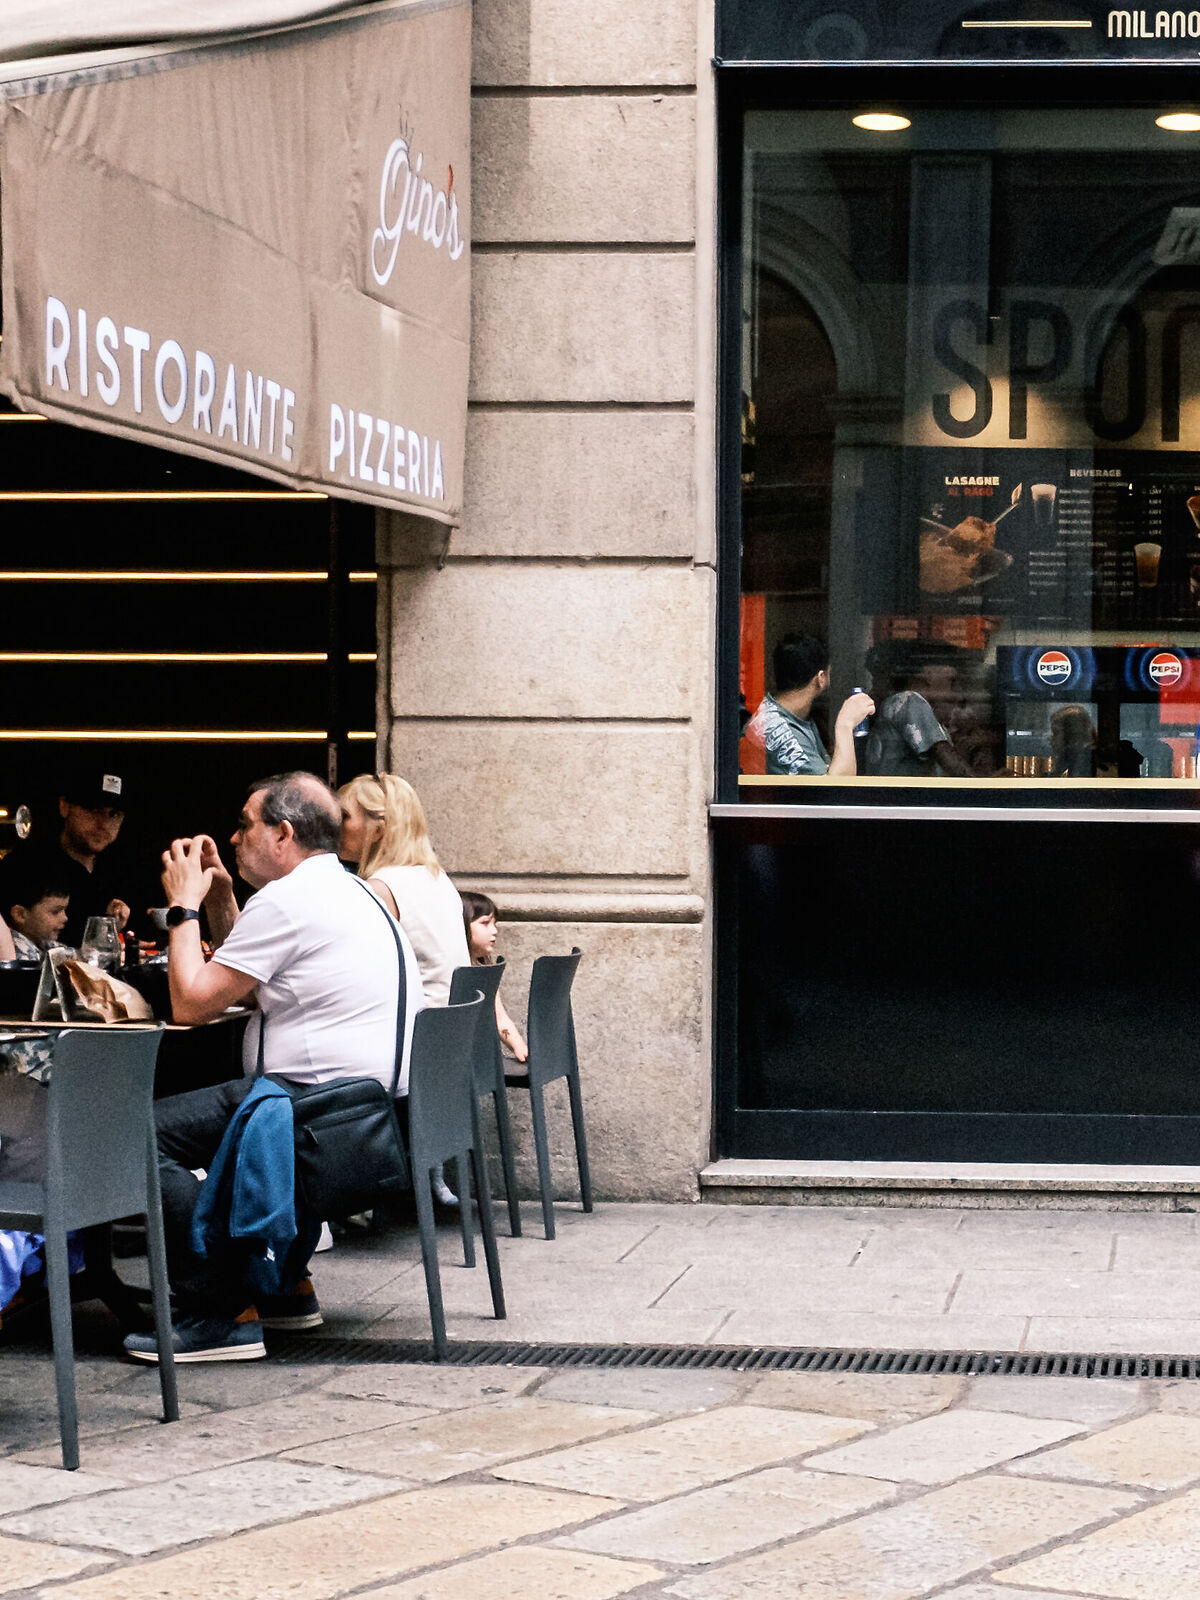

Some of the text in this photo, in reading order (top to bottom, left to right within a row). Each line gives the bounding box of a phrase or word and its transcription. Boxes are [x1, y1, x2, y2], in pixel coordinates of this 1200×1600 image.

[45, 296, 296, 463] RISTORANTE
[328, 403, 446, 501] PIZZERIA
[1069, 469, 1122, 478] BEVERAGE
[944, 476, 1000, 486] LASAGNE
[1039, 664, 1069, 672] PEPSI
[1151, 665, 1180, 673] PEPSI
